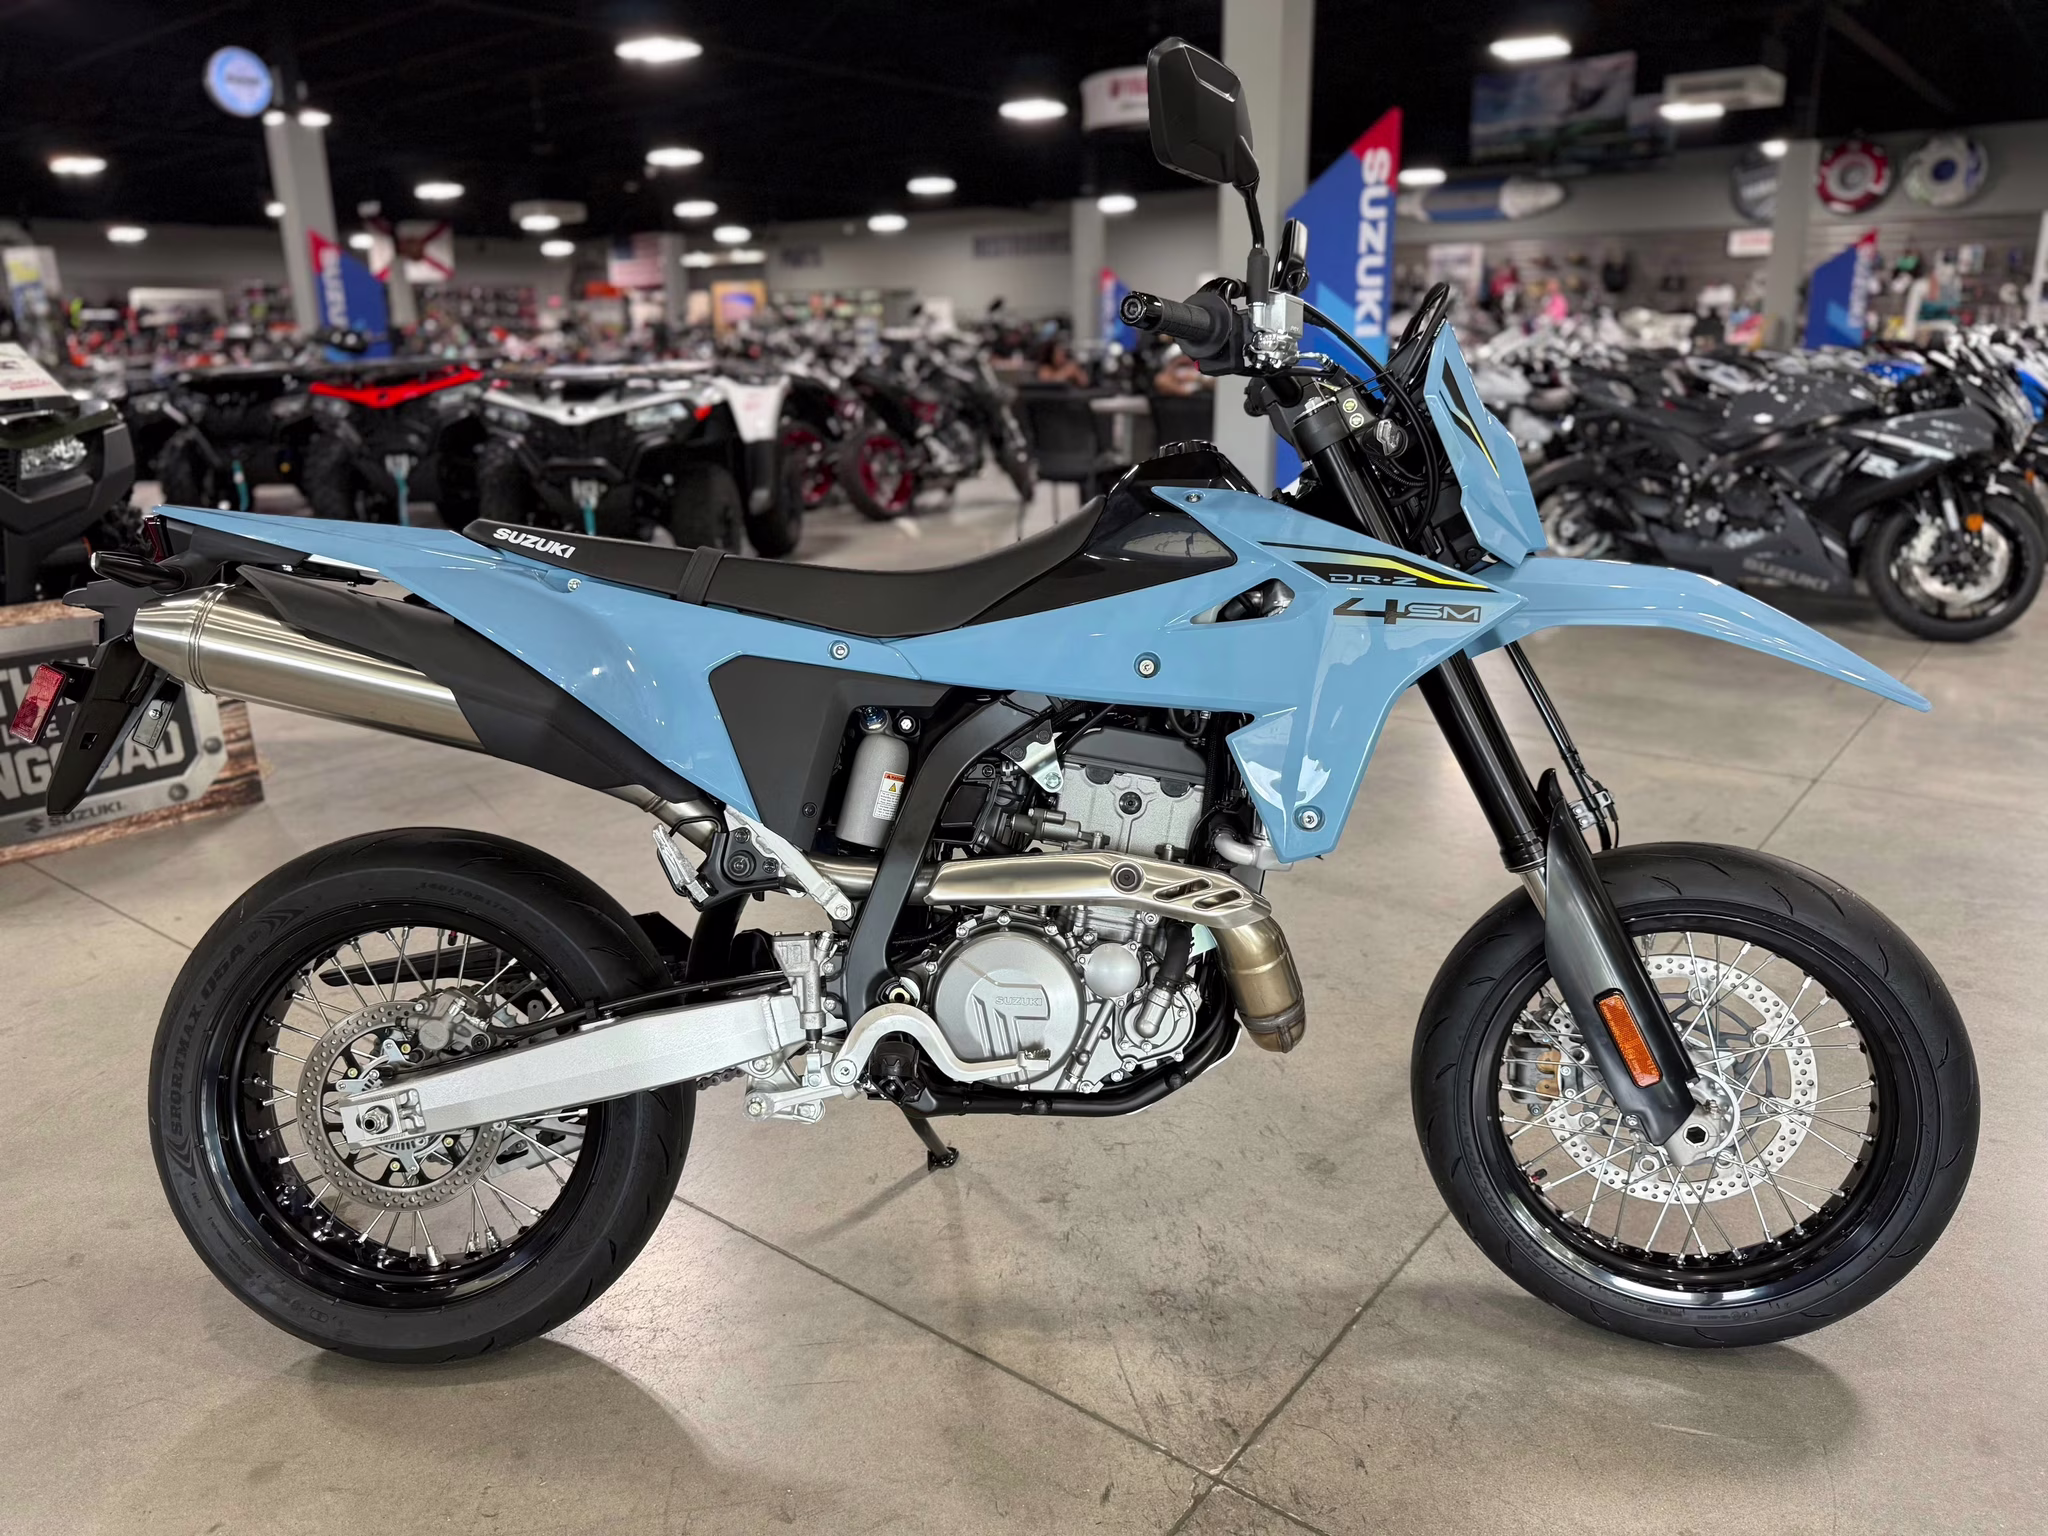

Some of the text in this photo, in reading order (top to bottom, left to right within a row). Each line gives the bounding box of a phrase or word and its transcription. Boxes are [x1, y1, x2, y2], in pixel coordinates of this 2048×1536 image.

[1354, 147, 1393, 338] SUZUKI
[493, 528, 576, 559] SUZUKI
[1328, 573, 1418, 586] DR-Z
[49, 801, 123, 827] SUZUKI
[995, 996, 1043, 1007] SUZUKI
